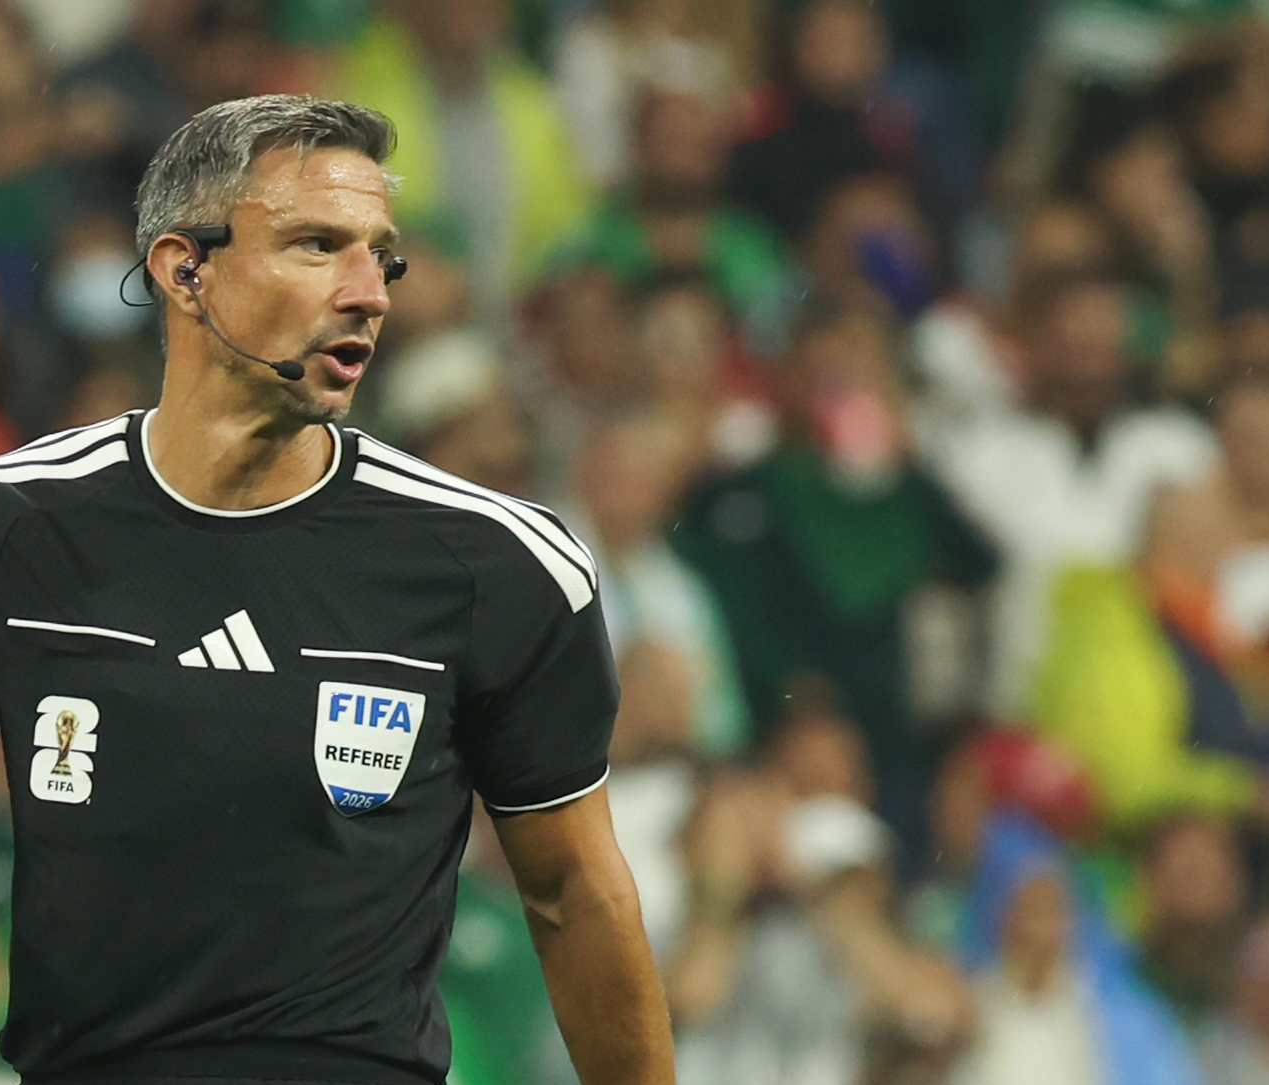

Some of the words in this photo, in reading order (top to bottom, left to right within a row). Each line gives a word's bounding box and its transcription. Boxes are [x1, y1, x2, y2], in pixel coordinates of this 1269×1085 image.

[329, 692, 411, 733] FIFA
[325, 745, 403, 770] REFEREE
[47, 780, 75, 793] FIFA
[339, 792, 374, 808] 2026
